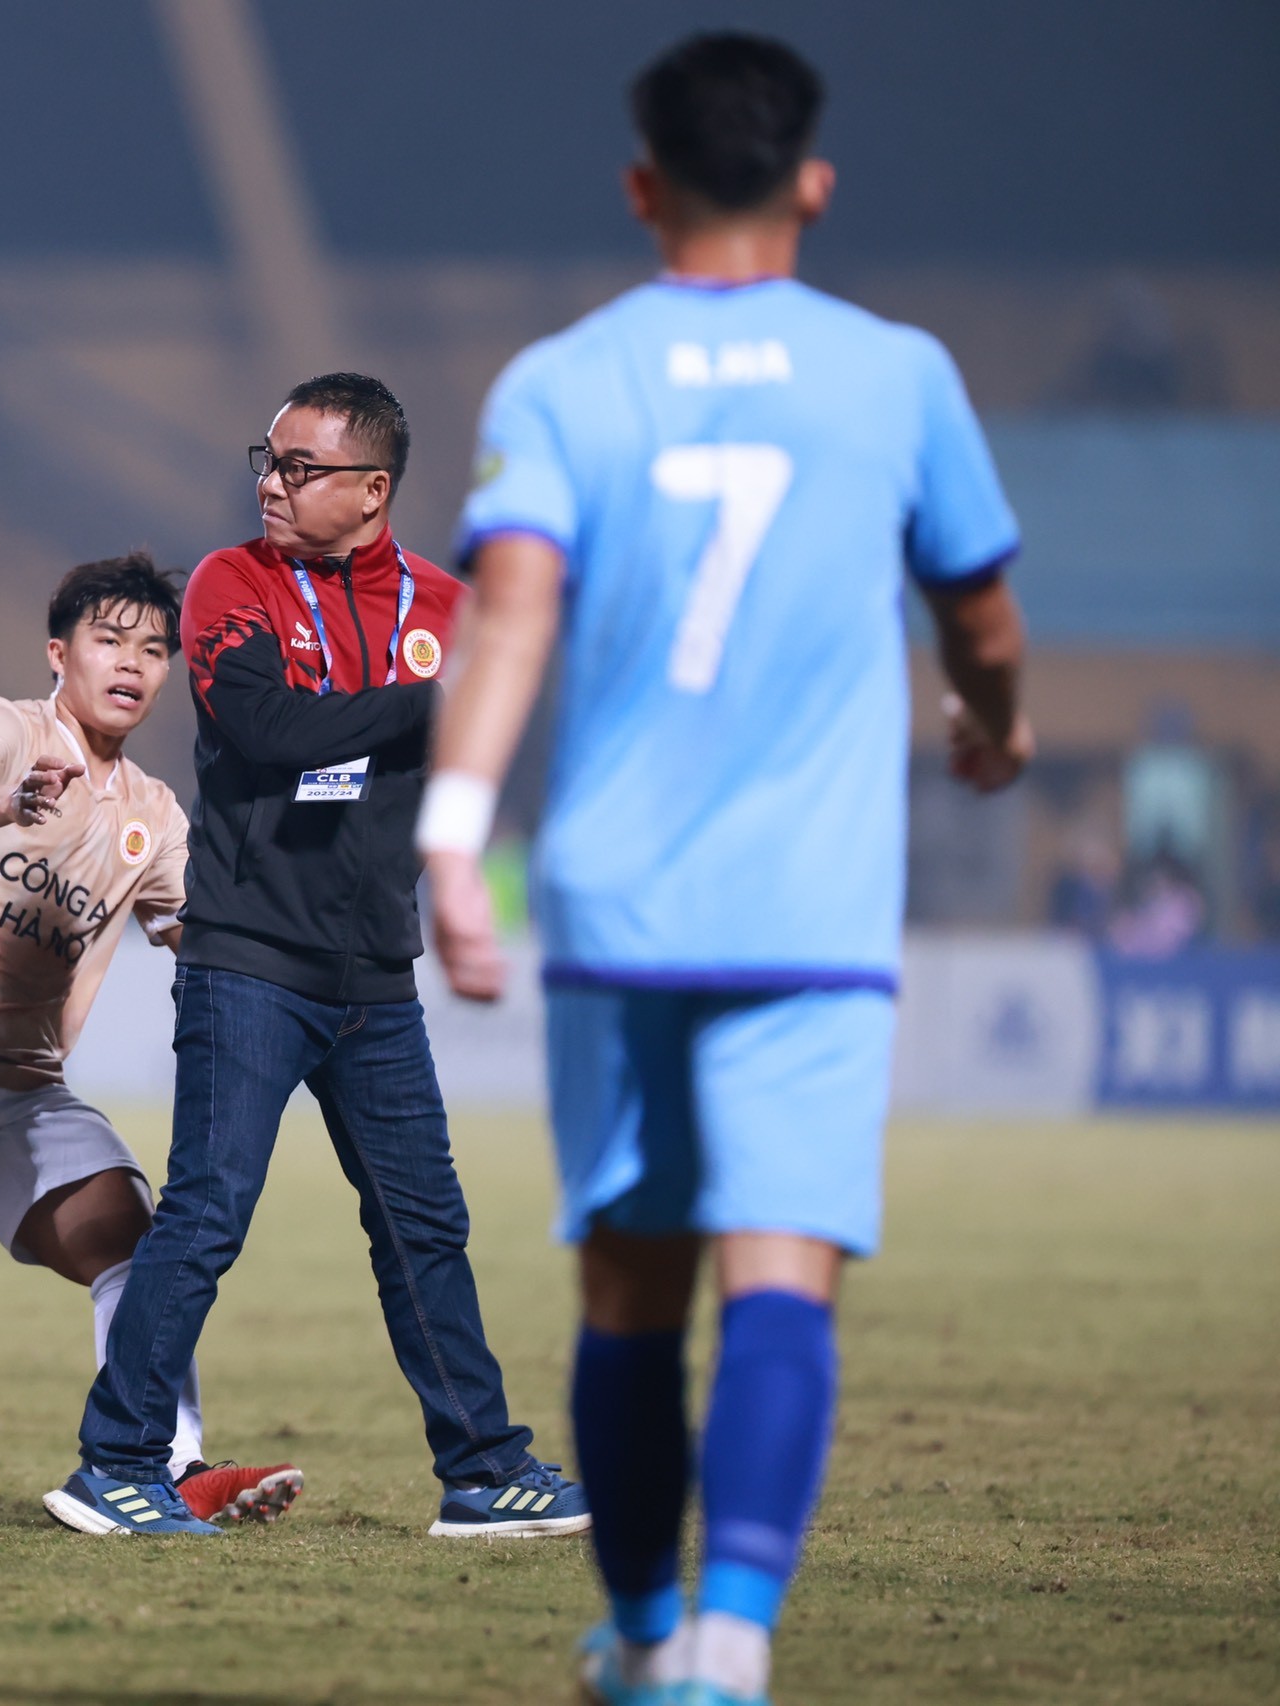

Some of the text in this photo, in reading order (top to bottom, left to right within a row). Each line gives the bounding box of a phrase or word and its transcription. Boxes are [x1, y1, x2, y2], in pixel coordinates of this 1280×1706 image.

[650, 442, 792, 695] 7
[300, 580, 317, 610] FOOTBALL
[316, 774, 351, 782] CLB
[0, 852, 108, 922] CÔNG A
